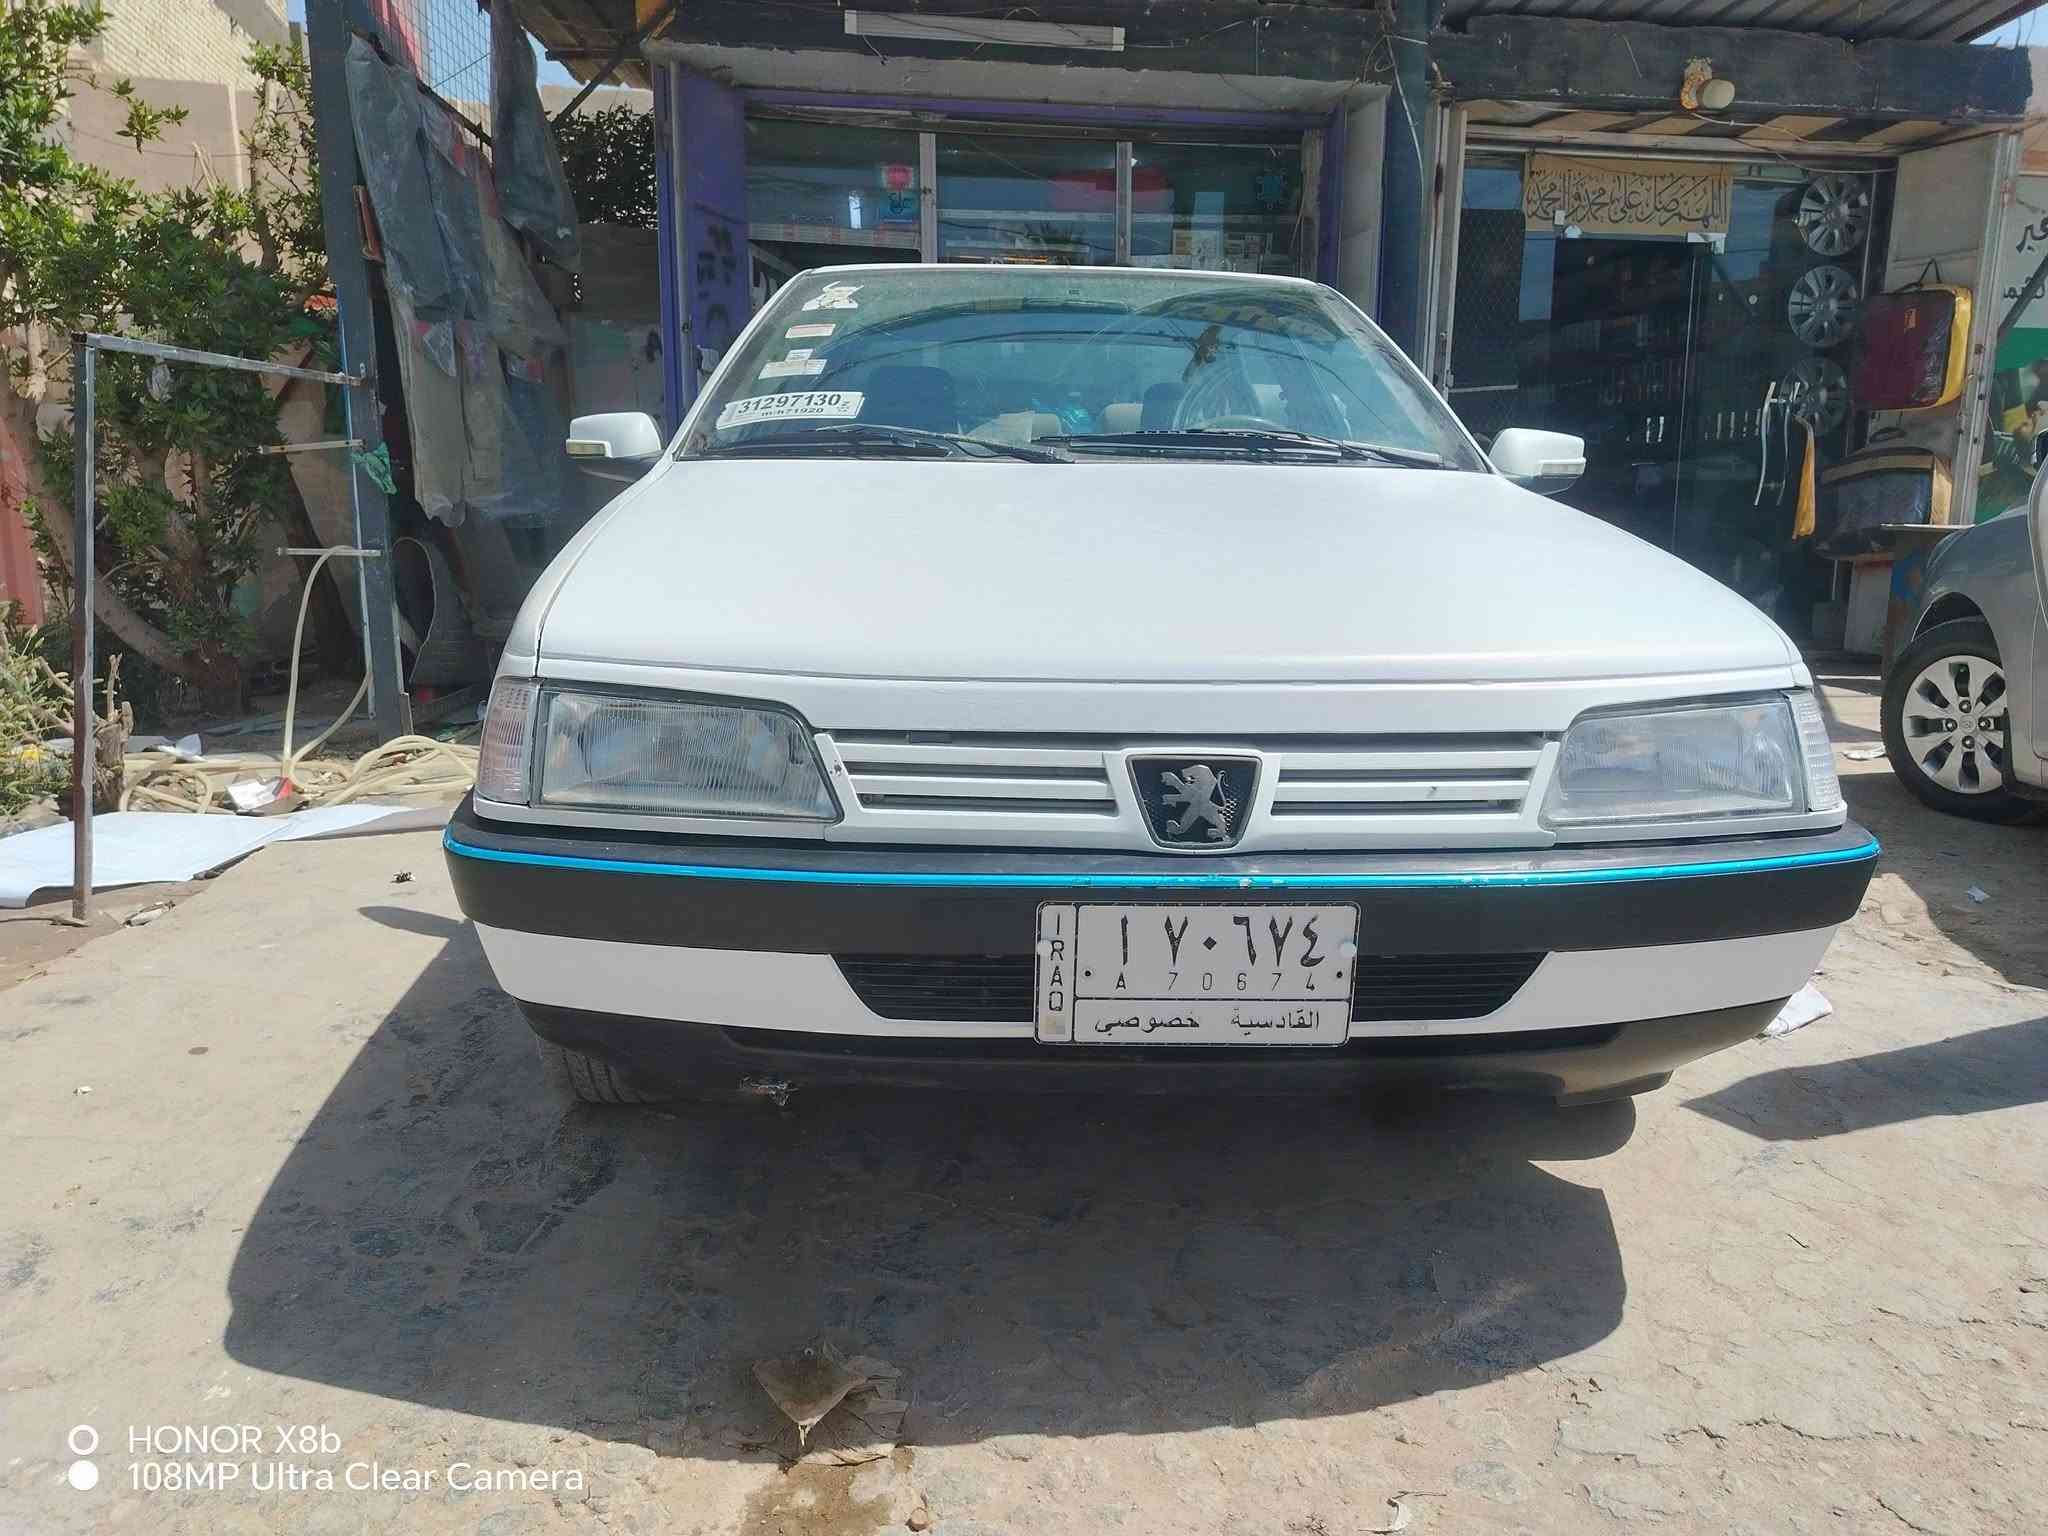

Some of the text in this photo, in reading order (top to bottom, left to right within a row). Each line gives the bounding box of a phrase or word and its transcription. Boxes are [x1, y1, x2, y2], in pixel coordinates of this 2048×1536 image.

[1049, 912, 1065, 1011] IRAQ
[1095, 1007, 1320, 1036] القادسية خصوصي
